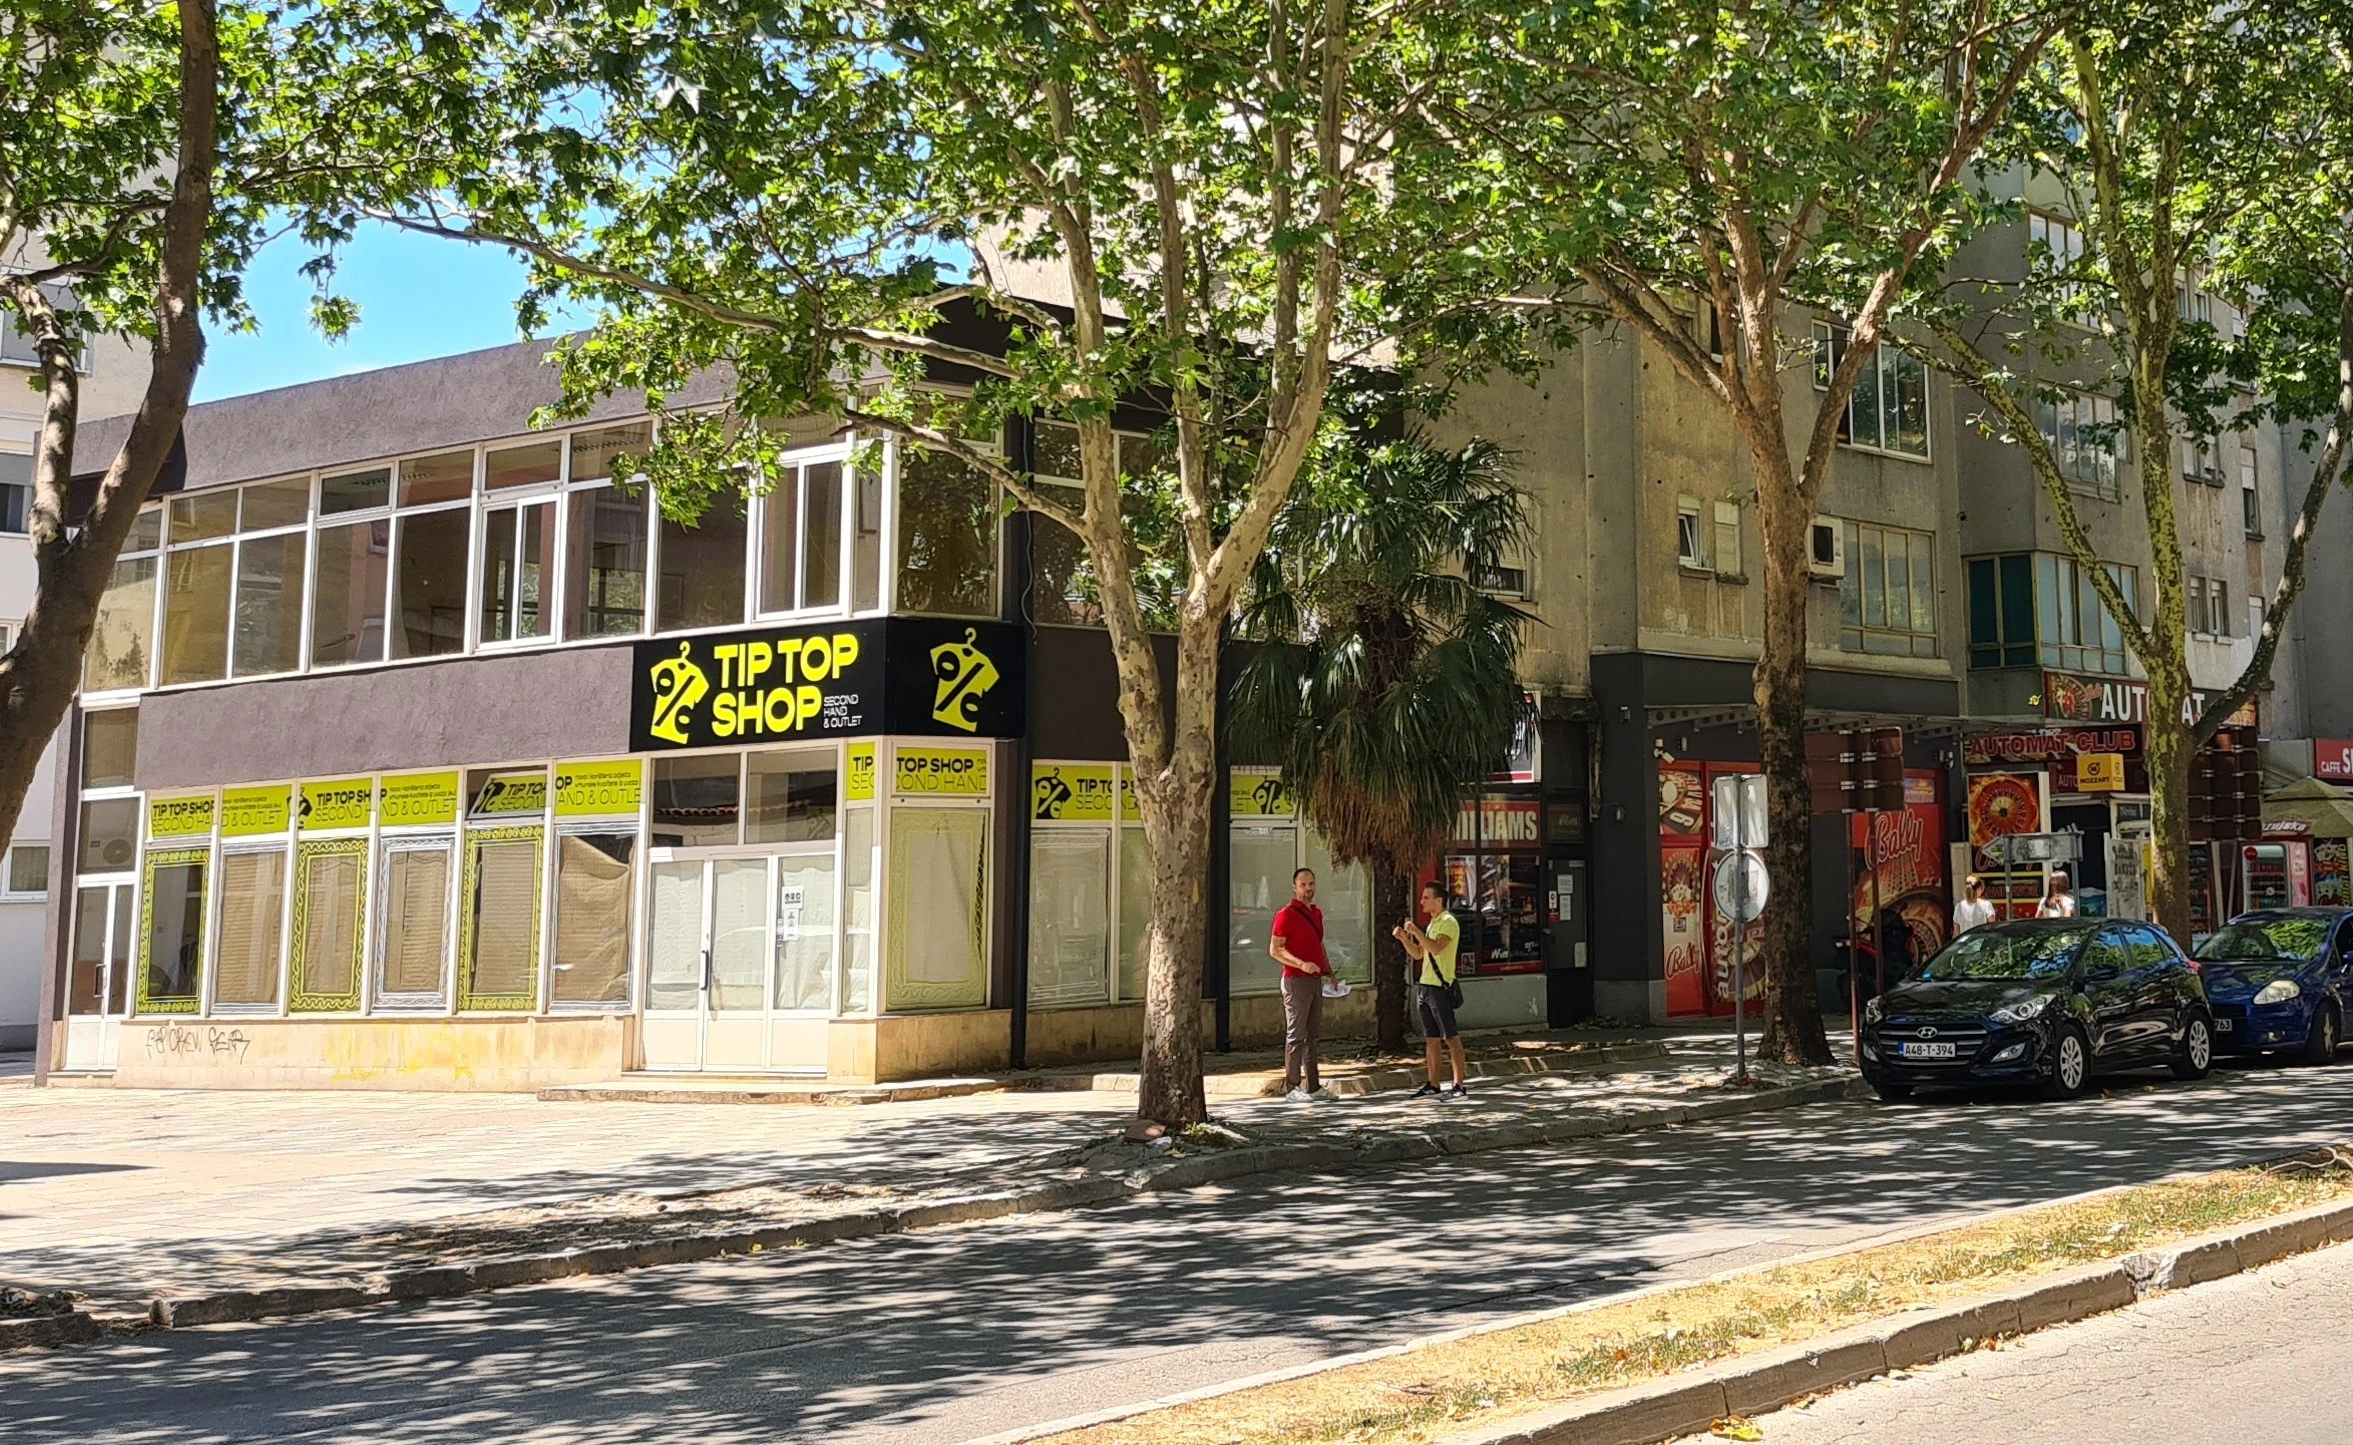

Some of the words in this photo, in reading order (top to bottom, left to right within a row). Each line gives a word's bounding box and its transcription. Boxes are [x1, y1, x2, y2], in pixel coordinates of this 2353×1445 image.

[713, 641, 772, 688] TIP
[777, 633, 859, 684] TOP
[824, 694, 859, 707] SECOND
[2100, 683, 2206, 727] AUTAT
[711, 685, 822, 737] SHOP
[824, 706, 848, 717] HAND
[823, 718, 830, 729] &
[831, 715, 863, 728] OUTLET
[1971, 733, 2072, 757] AUTOMAT
[2076, 730, 2136, 752] CLUB
[853, 755, 874, 772] TIP
[896, 757, 928, 773] TOP
[930, 757, 974, 774] SHOP
[2320, 760, 2341, 774] CAFFE
[1077, 778, 1098, 793] TIP
[2079, 776, 2110, 785] MOZZART
[316, 792, 333, 807] TIP
[333, 790, 356, 805] TOP
[356, 787, 388, 804] SHP
[506, 783, 526, 797] TIP
[599, 787, 642, 806] OUTLE
[152, 803, 168, 818] TIP
[168, 802, 188, 816] TOP
[240, 809, 283, 827] OUTLET
[315, 804, 363, 822] SECOND
[1864, 804, 1924, 871] Bally
[1904, 1044, 1953, 1056] A48-T-394
